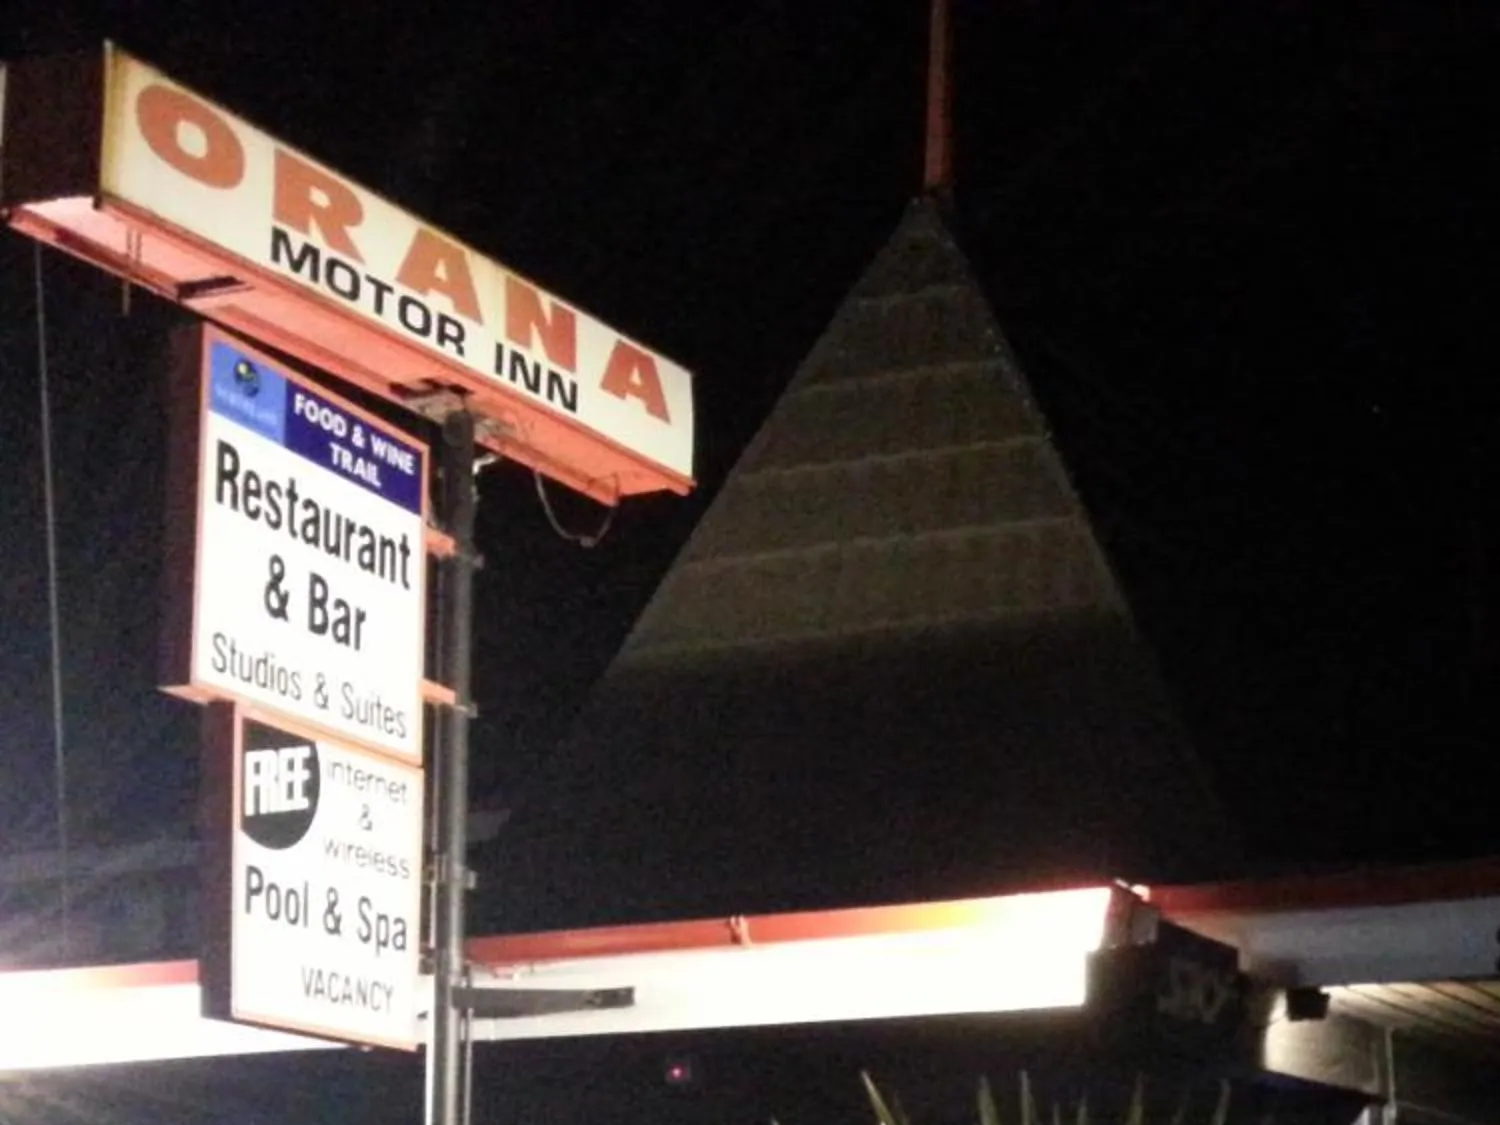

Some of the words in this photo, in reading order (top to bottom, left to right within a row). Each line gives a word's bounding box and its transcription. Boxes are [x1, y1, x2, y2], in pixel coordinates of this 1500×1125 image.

[136, 82, 671, 425] ORANA
[269, 226, 468, 358] MOTOR
[493, 341, 579, 414] INN
[293, 393, 347, 439] FOOD
[352, 424, 366, 449] &
[370, 432, 415, 476] WINE
[329, 442, 382, 488] TRAIL
[214, 438, 411, 591] Restaurant
[263, 554, 290, 622] &
[307, 571, 367, 652] Bar
[211, 632, 302, 702] Studios
[313, 673, 329, 711] &
[340, 681, 408, 740] Suites
[359, 803, 374, 832] &
[245, 865, 310, 929] Pool
[323, 887, 343, 936] &
[357, 895, 408, 957] Spa
[301, 964, 395, 1014] VACANCY
